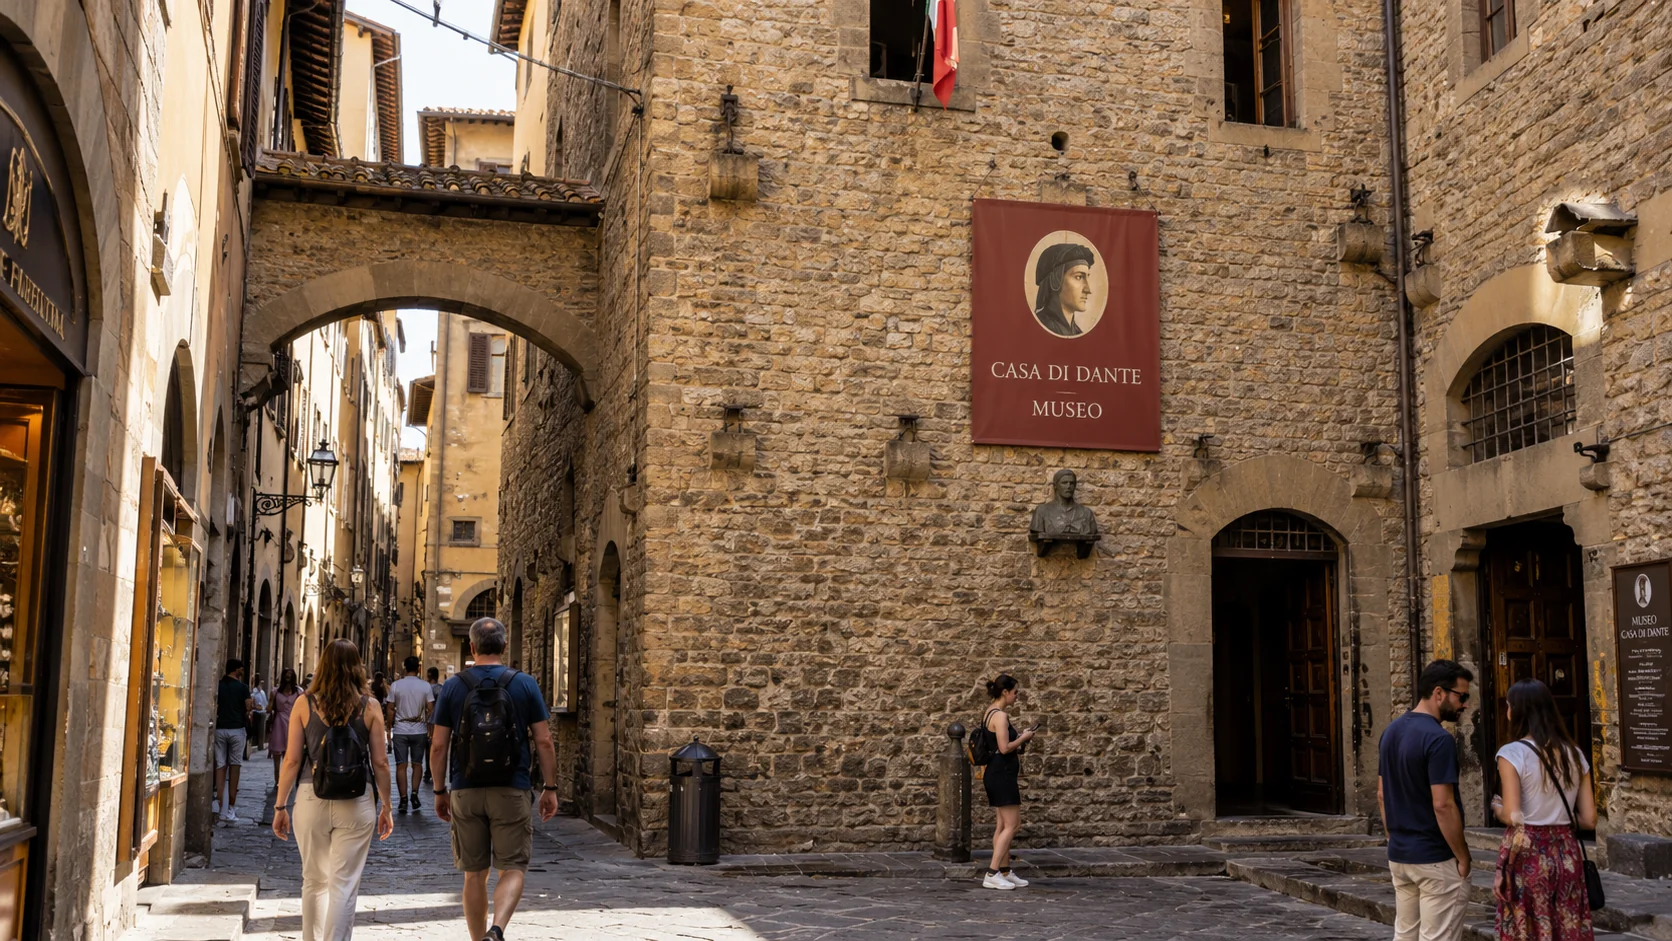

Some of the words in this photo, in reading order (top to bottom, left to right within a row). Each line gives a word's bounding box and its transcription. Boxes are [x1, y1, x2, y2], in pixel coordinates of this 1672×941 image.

[991, 361, 1042, 380] CASA
[1048, 364, 1069, 381] DI
[1076, 365, 1142, 385] DANTE
[1032, 400, 1103, 420] MUSEO
[1632, 614, 1657, 626] MUSEO
[1621, 630, 1637, 639] CASA
[1638, 628, 1646, 638] DI
[1647, 627, 1669, 637] DANTE
